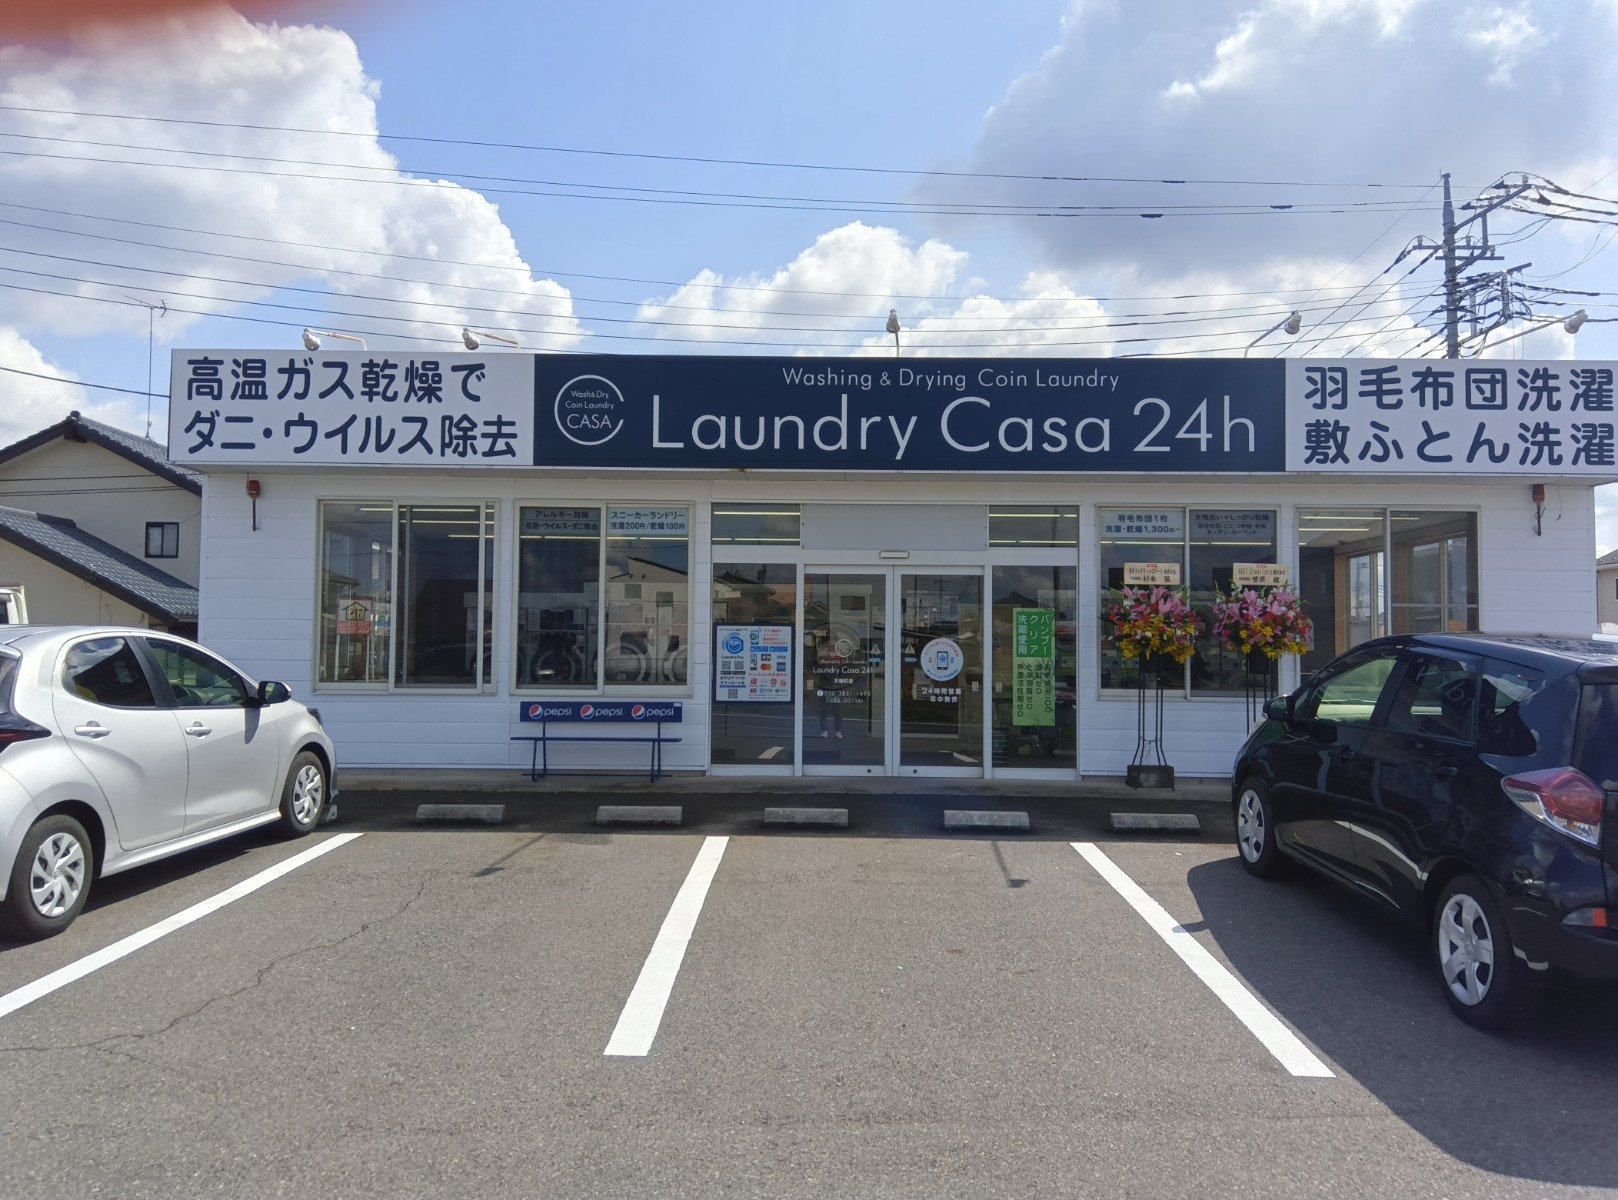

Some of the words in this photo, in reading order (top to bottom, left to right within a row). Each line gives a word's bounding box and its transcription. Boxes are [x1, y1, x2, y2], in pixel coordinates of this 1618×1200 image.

[186, 356, 486, 404] 高温ガス乾燥で
[782, 367, 872, 390] Washing
[879, 371, 892, 386] &
[900, 368, 966, 391] Drying
[978, 368, 1027, 387] Coin
[1036, 368, 1120, 391] Laundry
[1304, 365, 1614, 412] 羽毛布団洗濯
[565, 400, 583, 409] Coin
[584, 400, 615, 410] Laundry
[566, 413, 612, 429] CASA
[184, 409, 518, 458] ダニ・ウイルス除去
[652, 393, 918, 460] Laundry
[940, 396, 1110, 453] Casa
[1132, 395, 1256, 453] 24h
[1304, 418, 1616, 466] 敷ふとん洗濯
[611, 511, 685, 520] スニーカーランドリー
[1117, 514, 1168, 523] 羽毛布団1枚
[1017, 614, 1028, 655] 洗剤使用
[1029, 615, 1039, 654] クリア
[1040, 614, 1050, 654] バンブー
[812, 666, 839, 675] Laundry
[841, 666, 860, 674] Casa
[861, 666, 876, 674] 24h
[543, 706, 572, 717] pepsi
[595, 706, 623, 717] pepsi
[646, 706, 674, 717] pepsi
